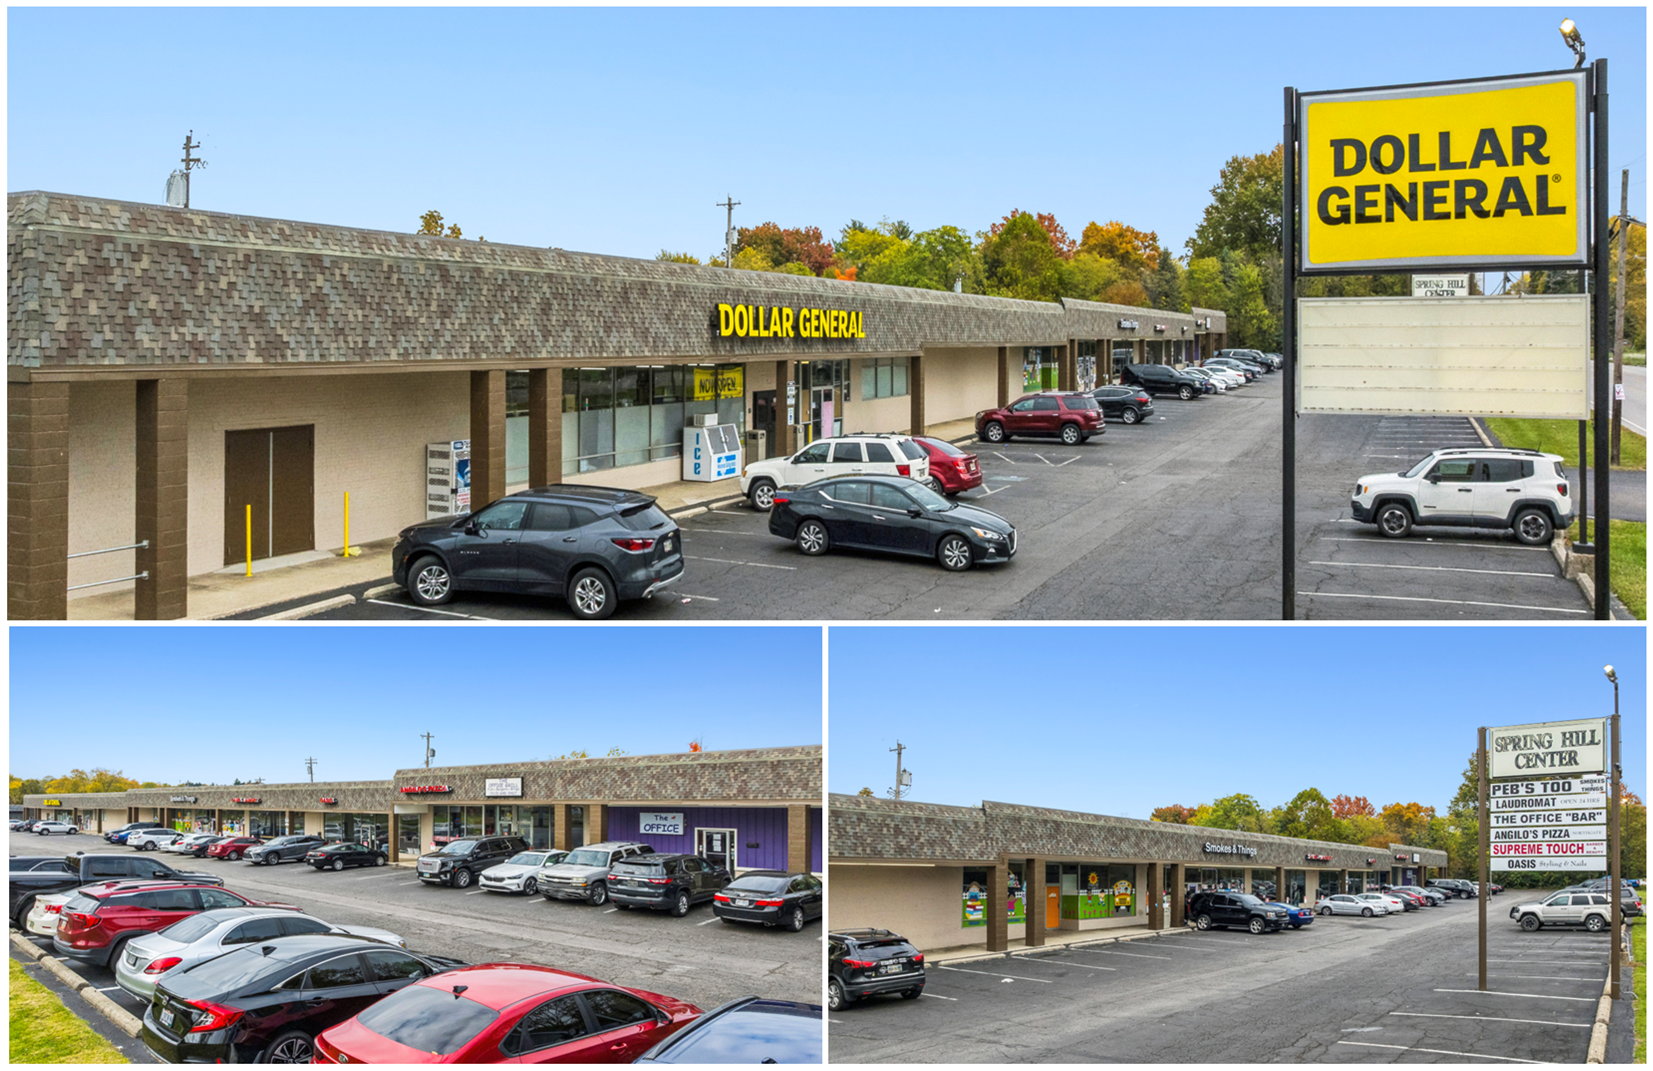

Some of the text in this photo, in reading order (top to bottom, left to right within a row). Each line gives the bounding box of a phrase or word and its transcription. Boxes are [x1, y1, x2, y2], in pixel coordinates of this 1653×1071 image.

[1330, 125, 1550, 177] DOLLAR
[1415, 280, 1466, 289] SPRING HILL
[718, 303, 865, 338] DOLLAR GENERAL
[1495, 729, 1601, 753] SPRING HILL
[1515, 750, 1579, 769] CENTER
[1492, 781, 1572, 796] PEB'S TOO
[1496, 798, 1557, 809] LAUDROMAT
[1494, 812, 1602, 824] THE OFFICE "BAR"
[643, 823, 680, 833] OFFICE
[1494, 829, 1539, 840] ANGILO'S
[1542, 829, 1570, 839] PIZZA
[1205, 842, 1257, 857] Smokes & Things
[1493, 843, 1584, 855] SUPREME TOUCH
[1508, 859, 1536, 869] OASIS
[1539, 859, 1562, 868] Styling
